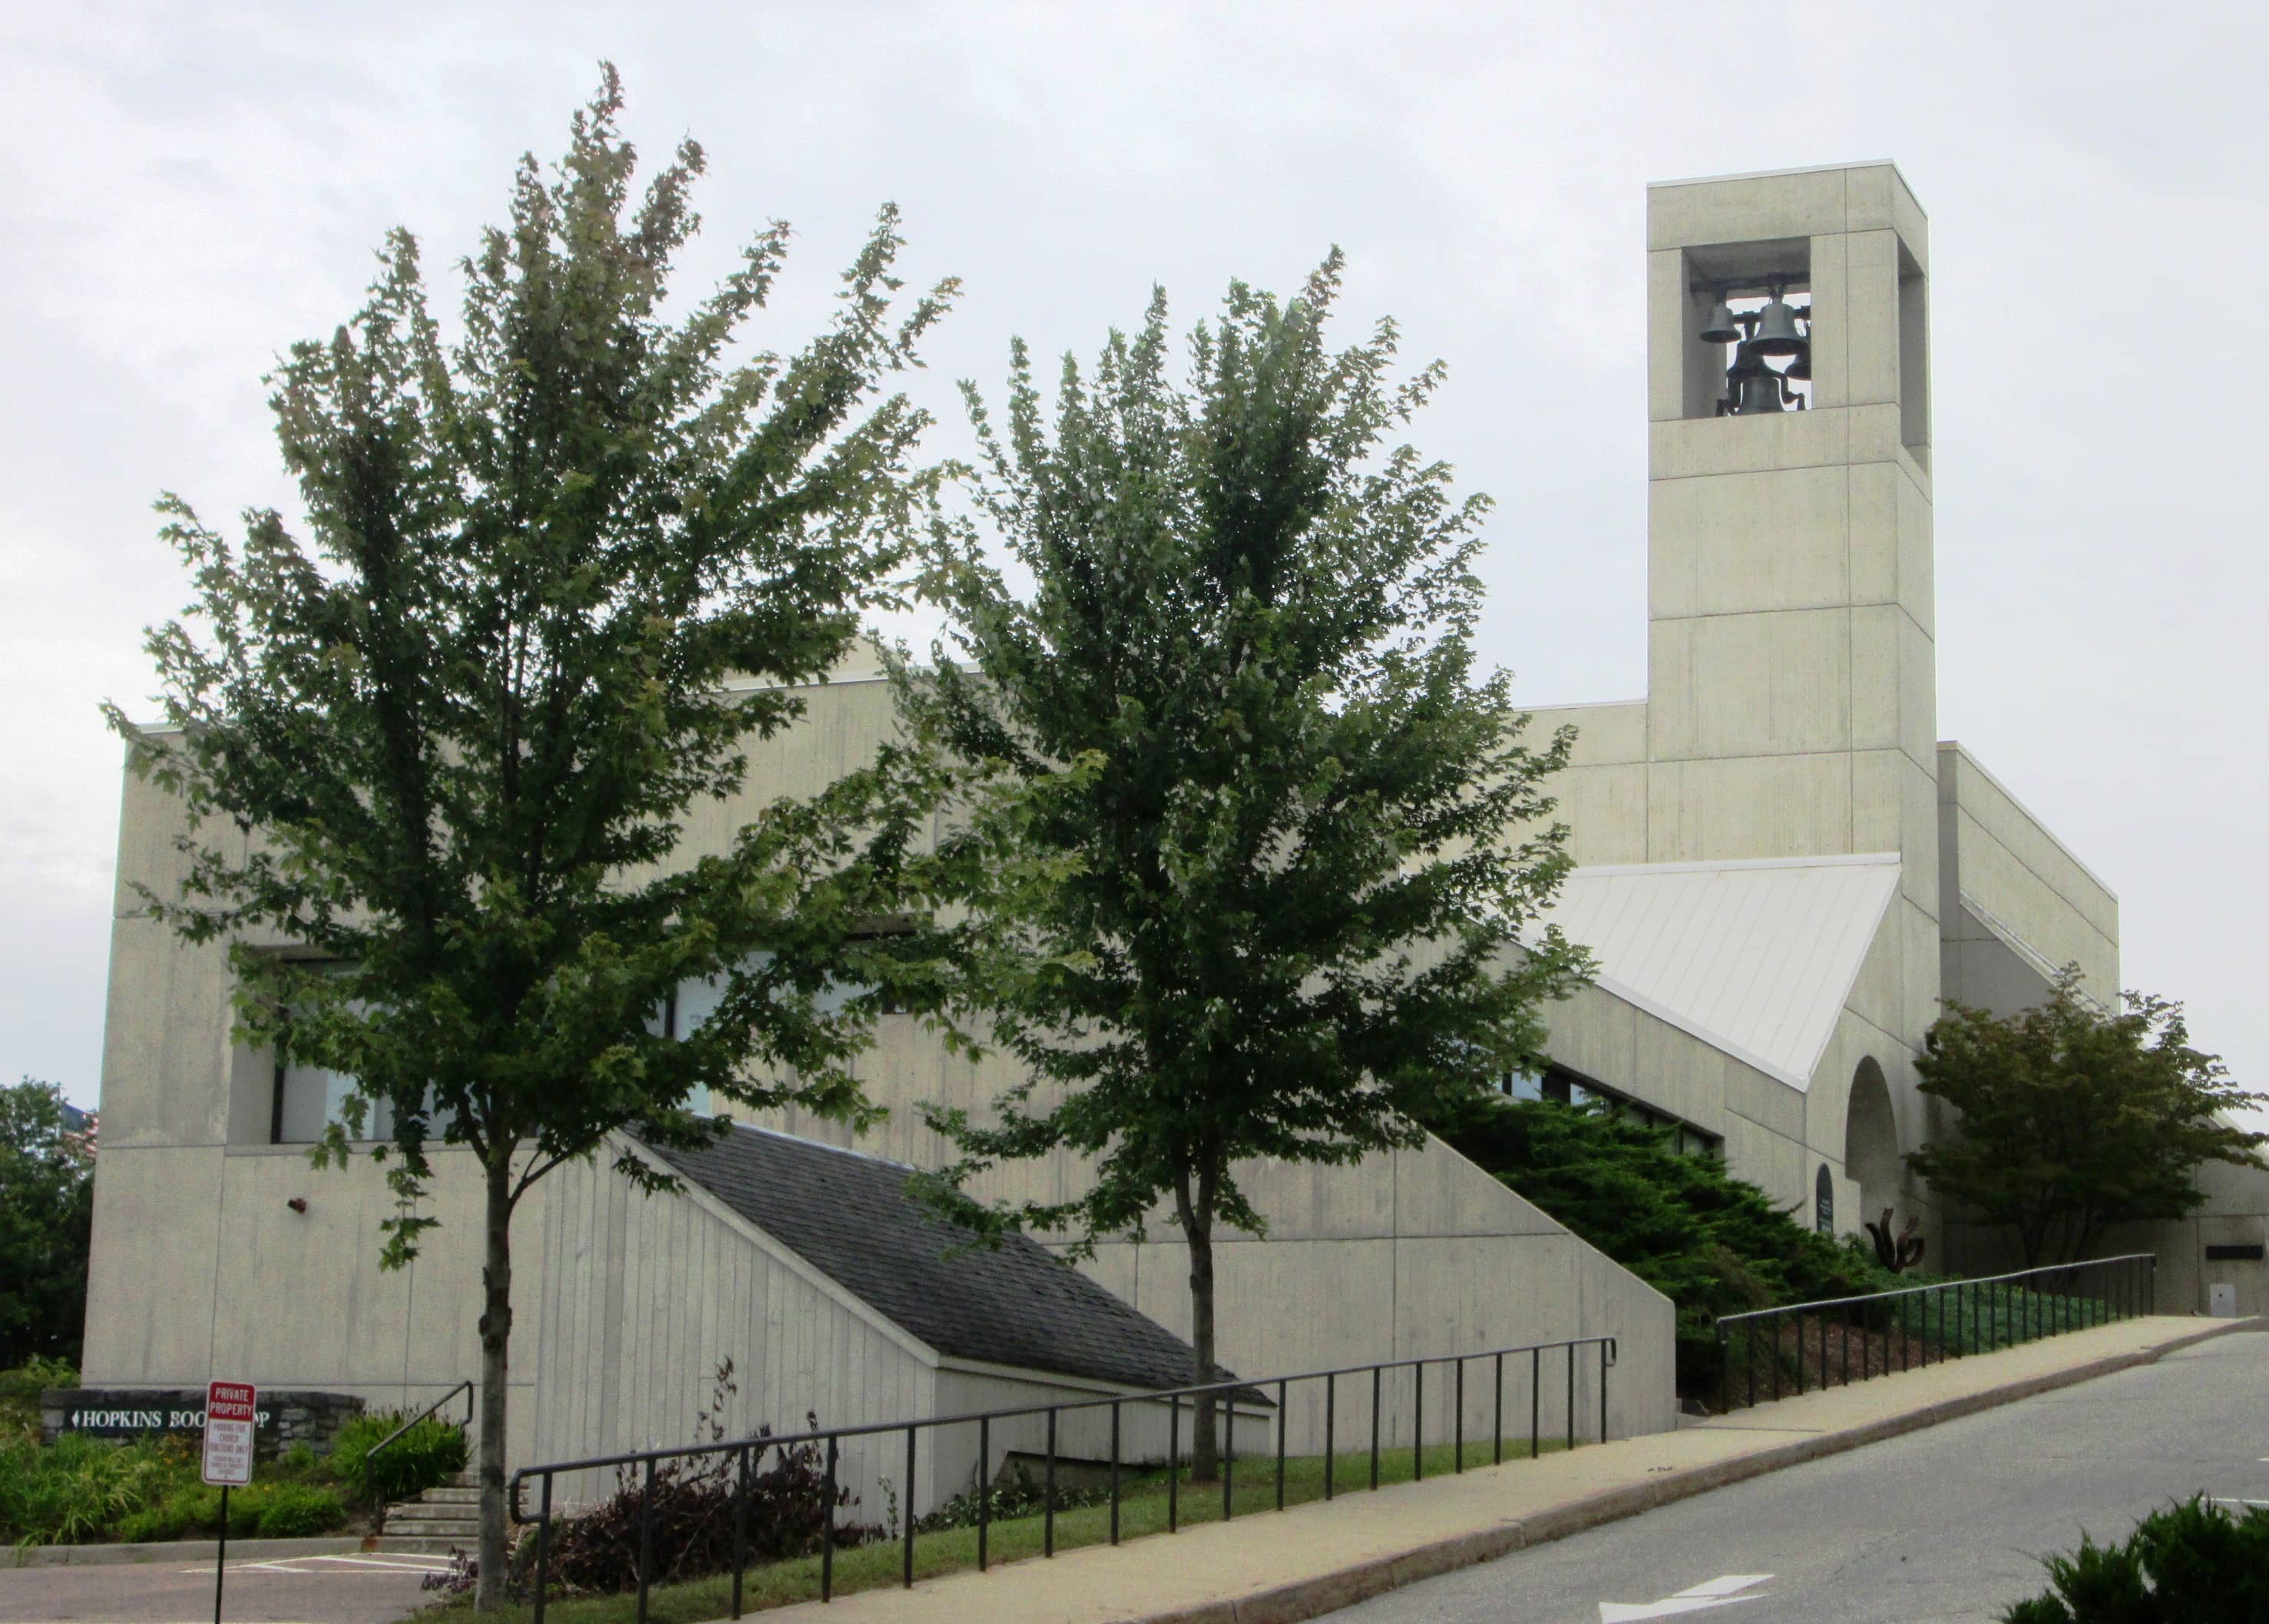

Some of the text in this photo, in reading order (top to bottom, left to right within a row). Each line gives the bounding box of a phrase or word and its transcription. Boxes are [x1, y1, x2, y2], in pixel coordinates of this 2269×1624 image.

[216, 1388, 249, 1401] PRIVATE
[209, 1402, 252, 1416] PROPERTY
[82, 1410, 162, 1428] HOPKINS
